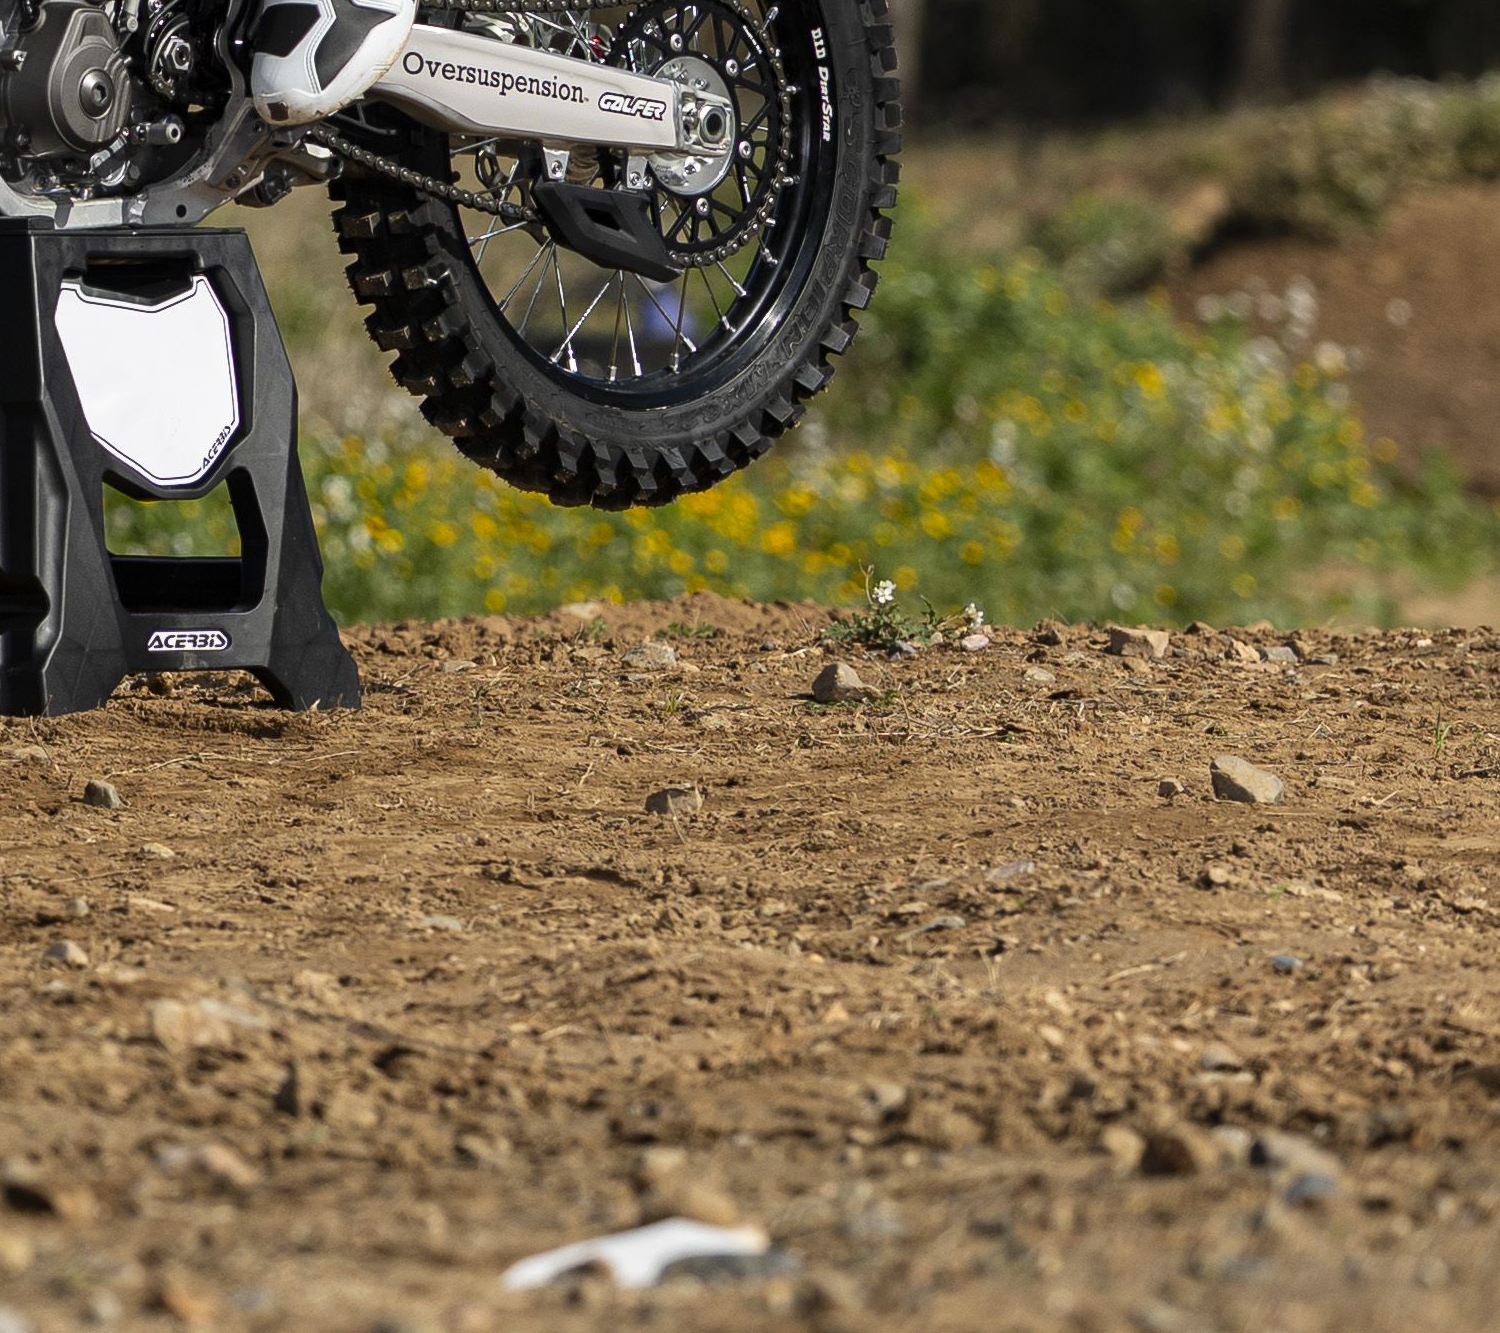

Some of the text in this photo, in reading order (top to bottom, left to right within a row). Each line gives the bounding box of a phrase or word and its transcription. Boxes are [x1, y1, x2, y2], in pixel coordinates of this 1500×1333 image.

[403, 51, 585, 104] Oversuspension
[599, 93, 667, 120] GALFER
[148, 631, 230, 651] ACERBIS
